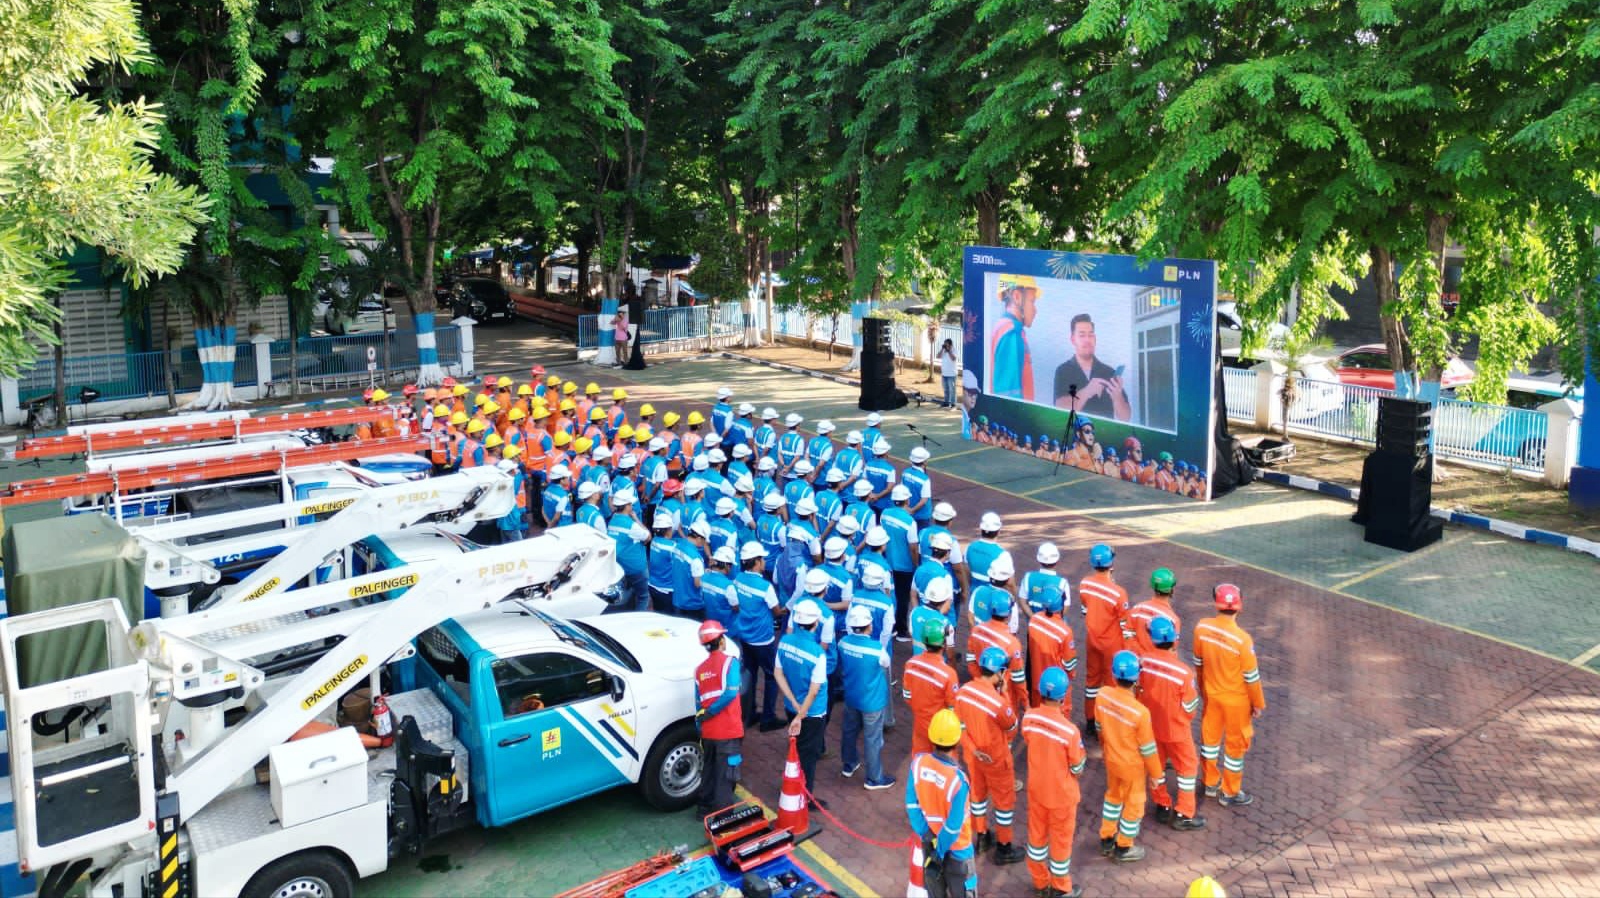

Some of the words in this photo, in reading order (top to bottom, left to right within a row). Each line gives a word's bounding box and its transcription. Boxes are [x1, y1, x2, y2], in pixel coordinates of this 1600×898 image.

[1178, 270, 1201, 280] PLN
[304, 498, 355, 514] PALFINGER
[479, 566, 489, 579] P
[519, 559, 529, 569] A
[353, 575, 414, 596] PALFINGER
[304, 658, 365, 707] PALFINGER
[542, 748, 562, 761] PLN
